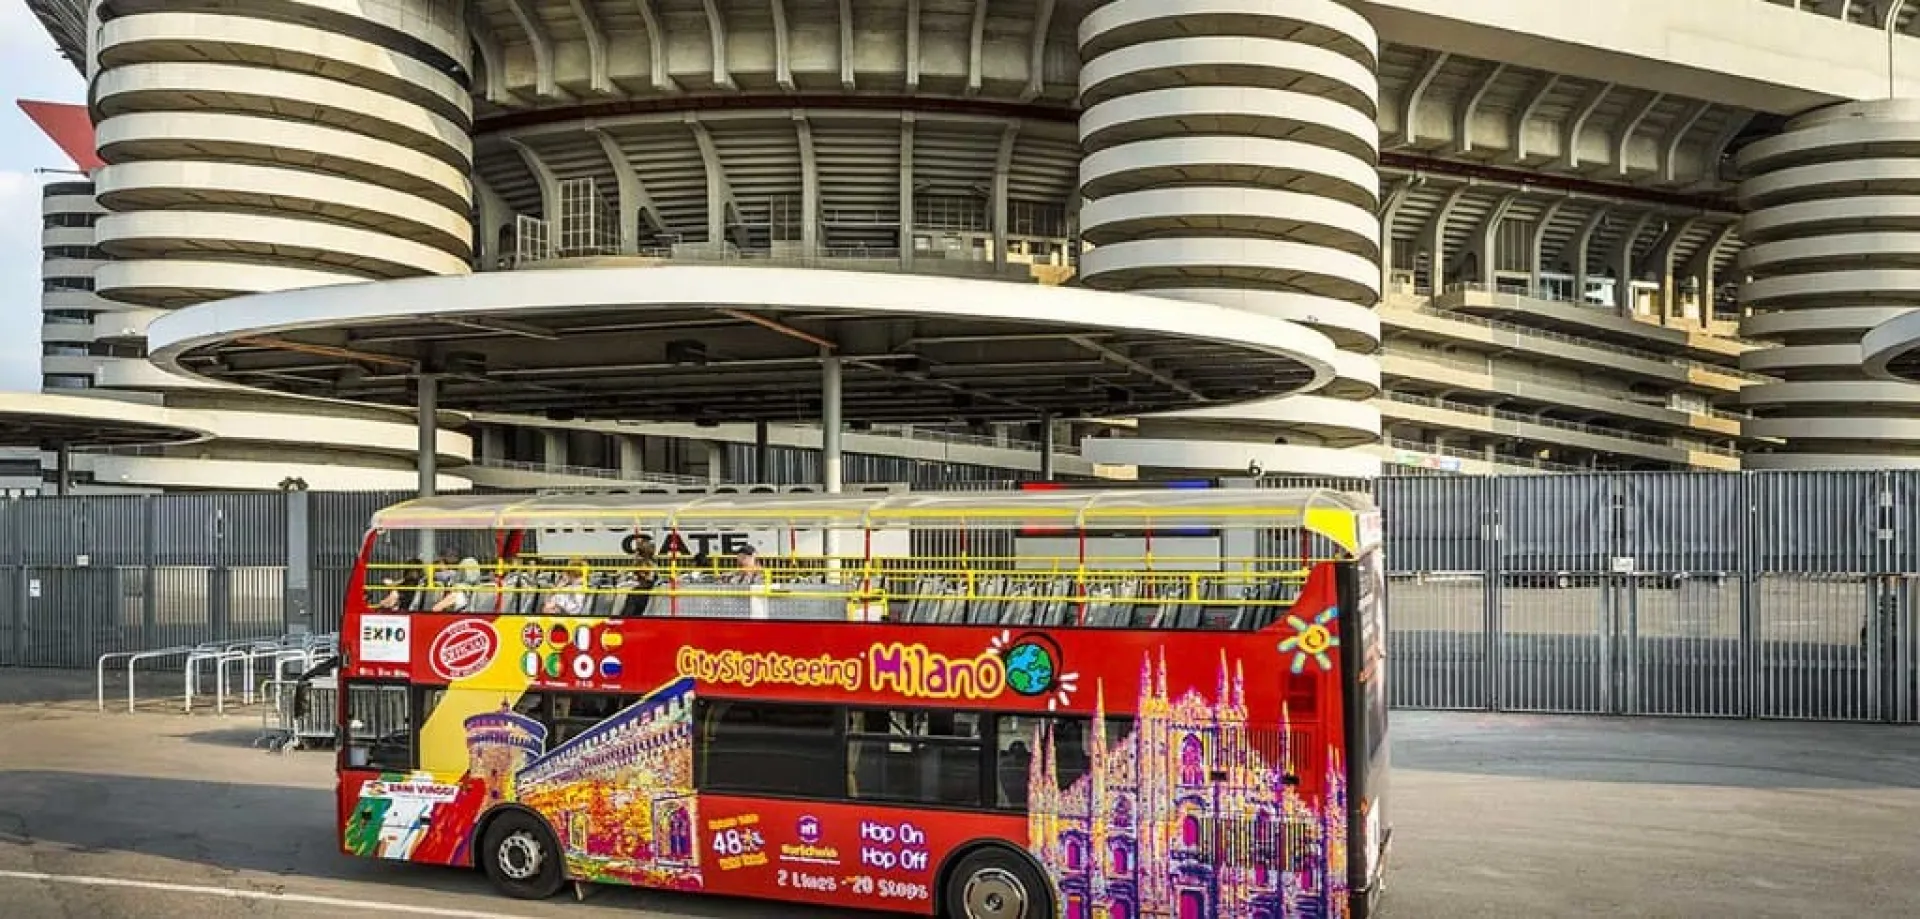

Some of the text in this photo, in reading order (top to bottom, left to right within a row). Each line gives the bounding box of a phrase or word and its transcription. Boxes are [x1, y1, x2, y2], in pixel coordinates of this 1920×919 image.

[364, 626, 406, 642] EXPO
[678, 643, 1004, 697] CitySightseeing Milano
[712, 829, 742, 856] 48
[861, 821, 924, 844] Hop On
[861, 847, 897, 869] Hop
[901, 849, 929, 870] Off
[777, 869, 788, 886] 2
[792, 871, 837, 891] Lines
[877, 878, 929, 900] Stops
